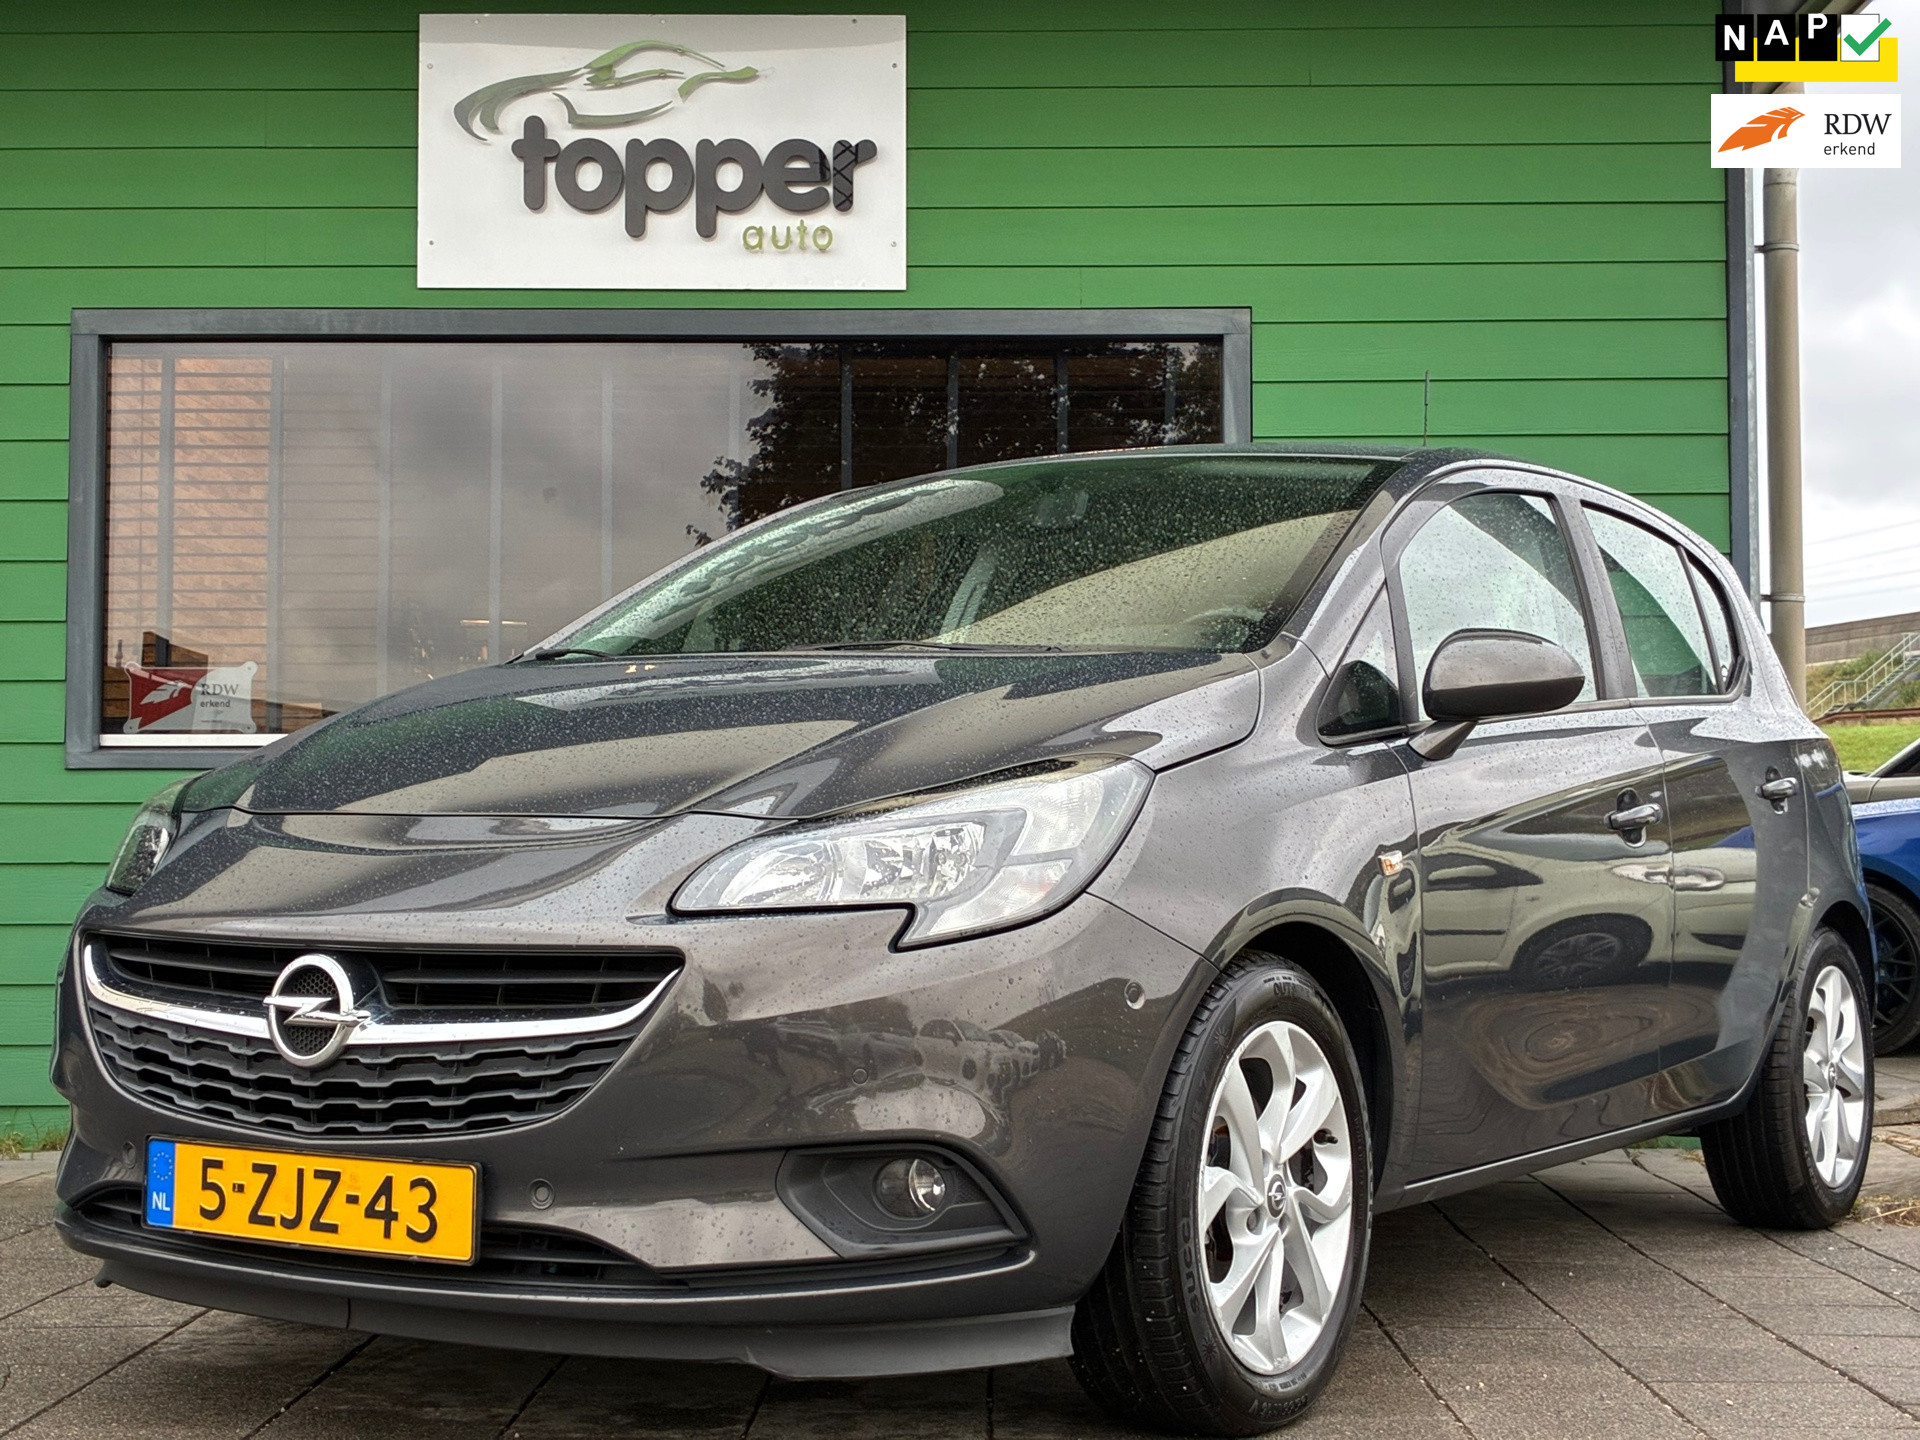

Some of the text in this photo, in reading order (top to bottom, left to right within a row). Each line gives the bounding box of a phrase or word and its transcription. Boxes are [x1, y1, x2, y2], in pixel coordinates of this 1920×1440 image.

[511, 115, 878, 238] topper
[742, 219, 834, 252] auto
[200, 683, 239, 695] RDW
[200, 699, 231, 708] erkend
[152, 1191, 171, 1212] NL
[200, 1158, 438, 1244] 5-ZJZ-43
